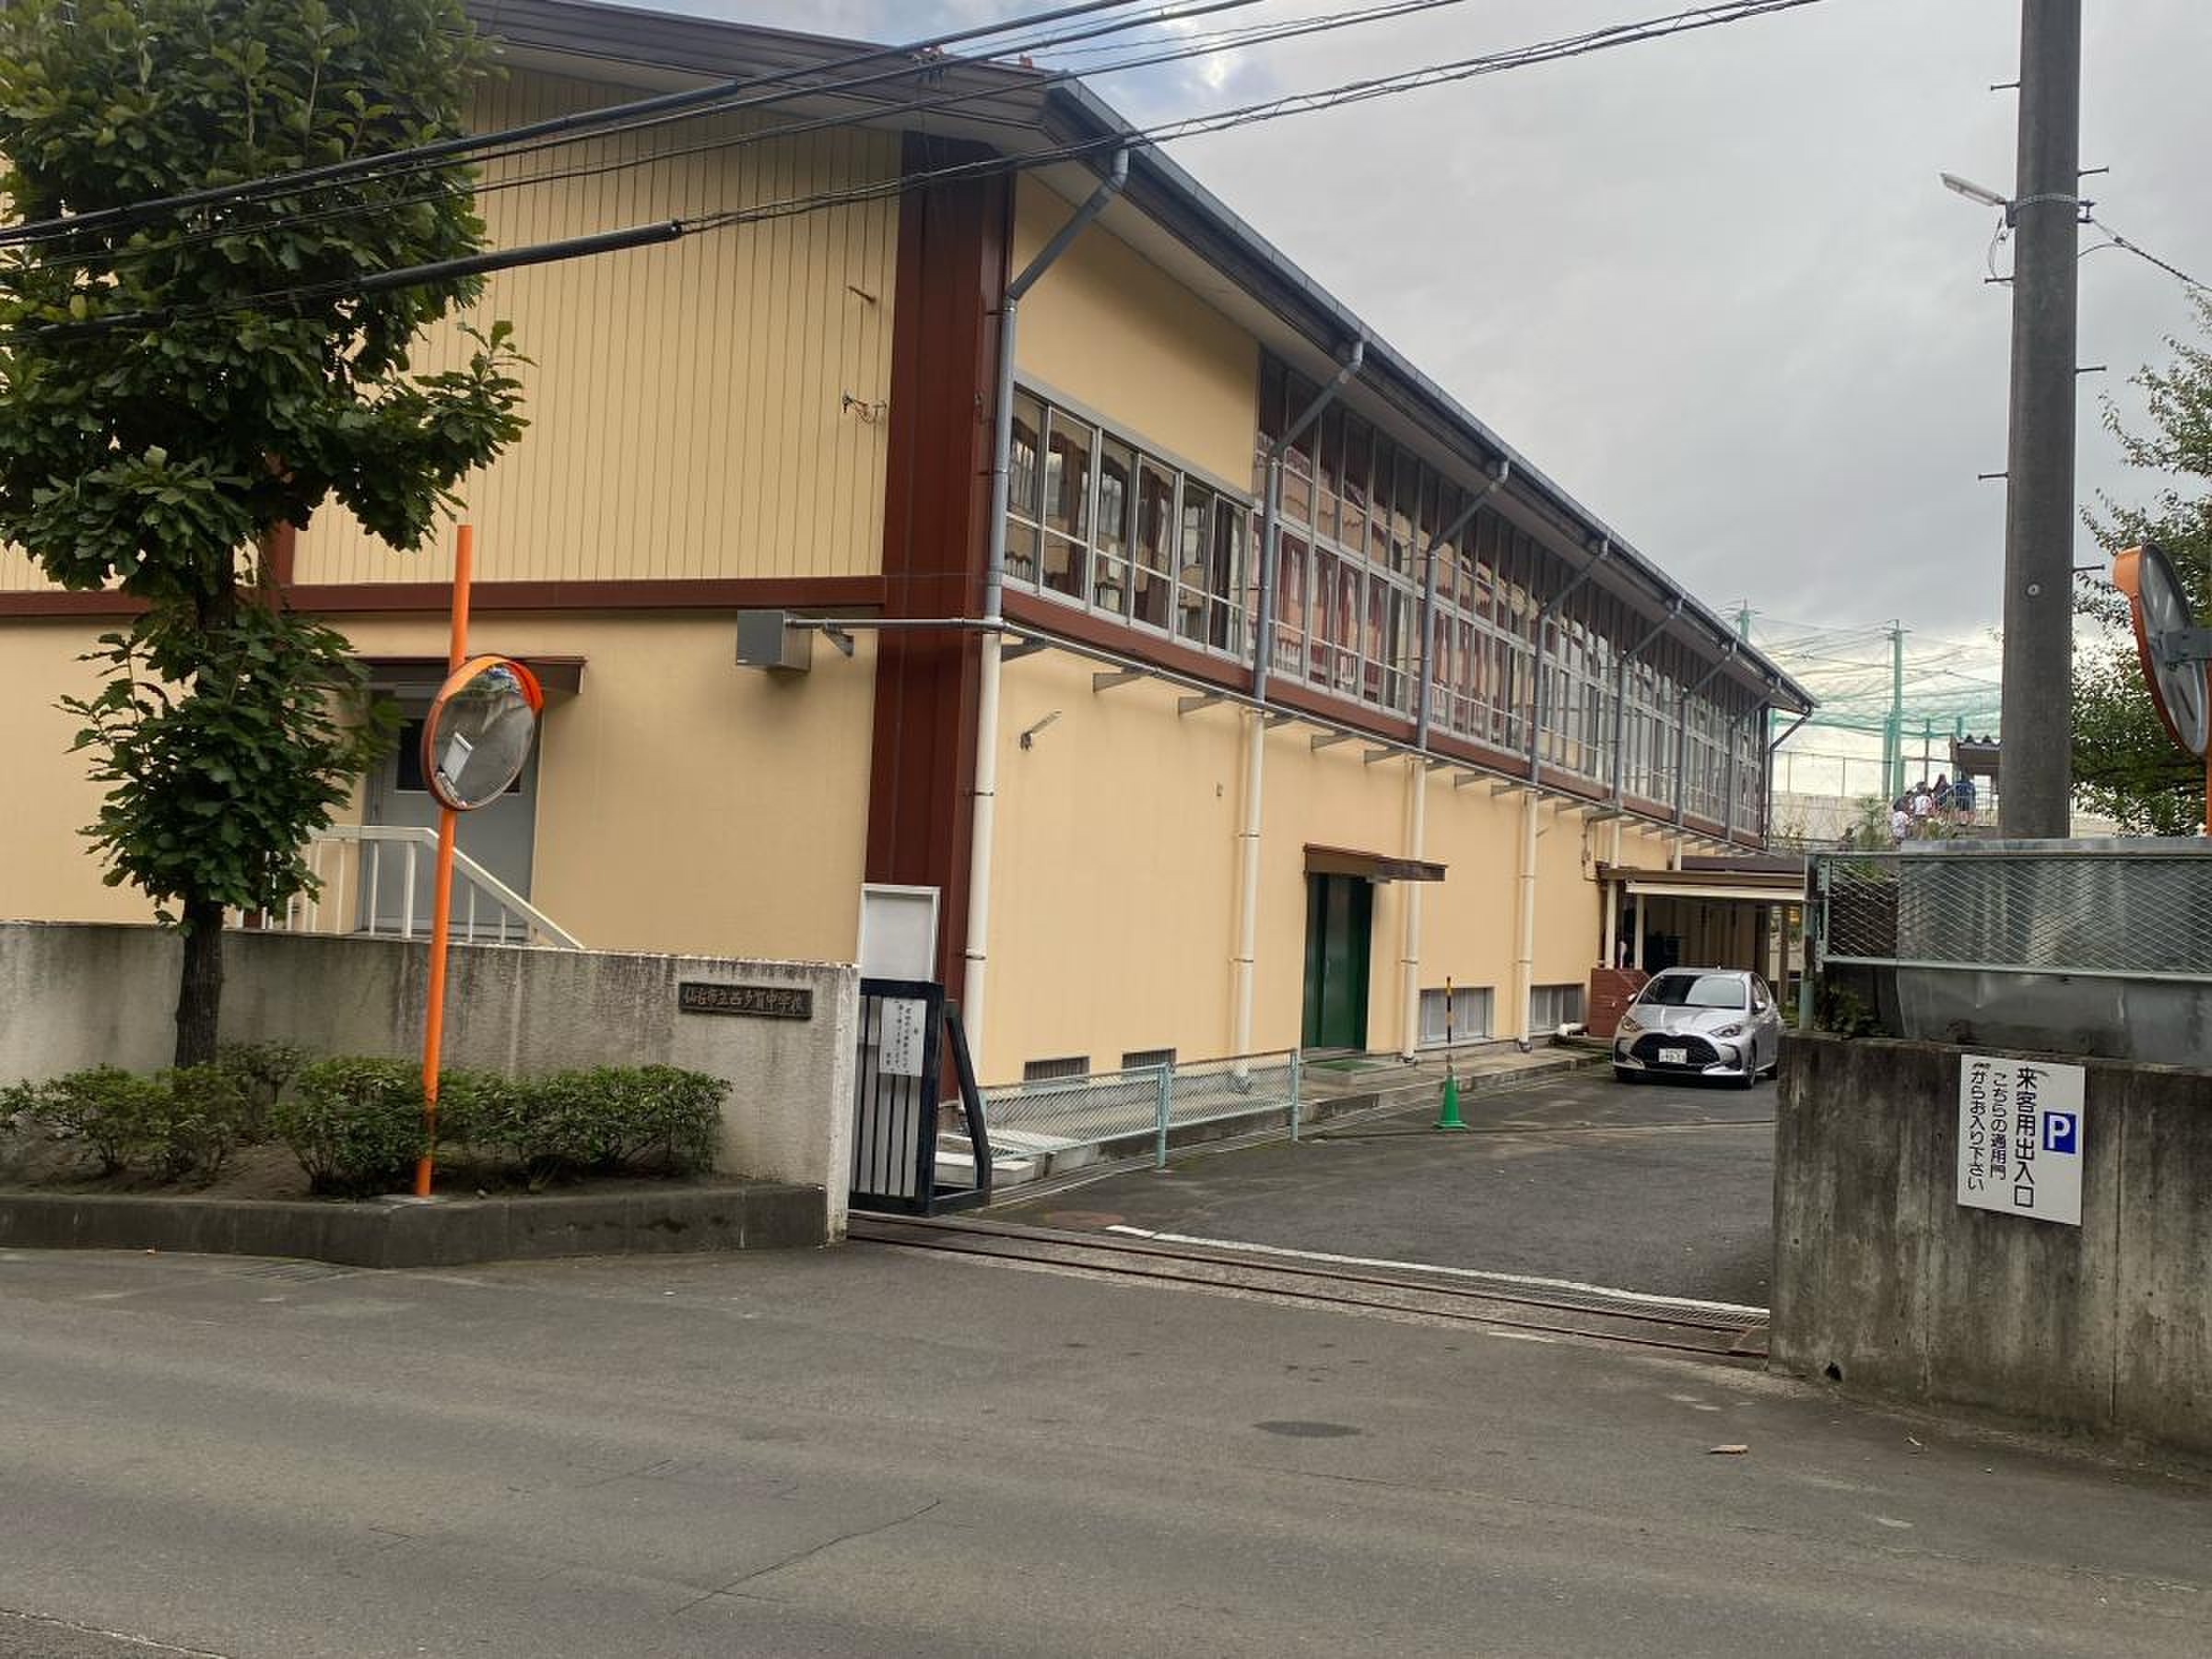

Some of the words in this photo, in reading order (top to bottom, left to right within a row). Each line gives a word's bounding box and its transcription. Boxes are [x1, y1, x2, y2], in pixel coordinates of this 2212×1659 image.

[1990, 1071, 2008, 1181] こちらの通用門
[2014, 1066, 2038, 1208] 来客用出入口
[2048, 1114, 2070, 1149] P
